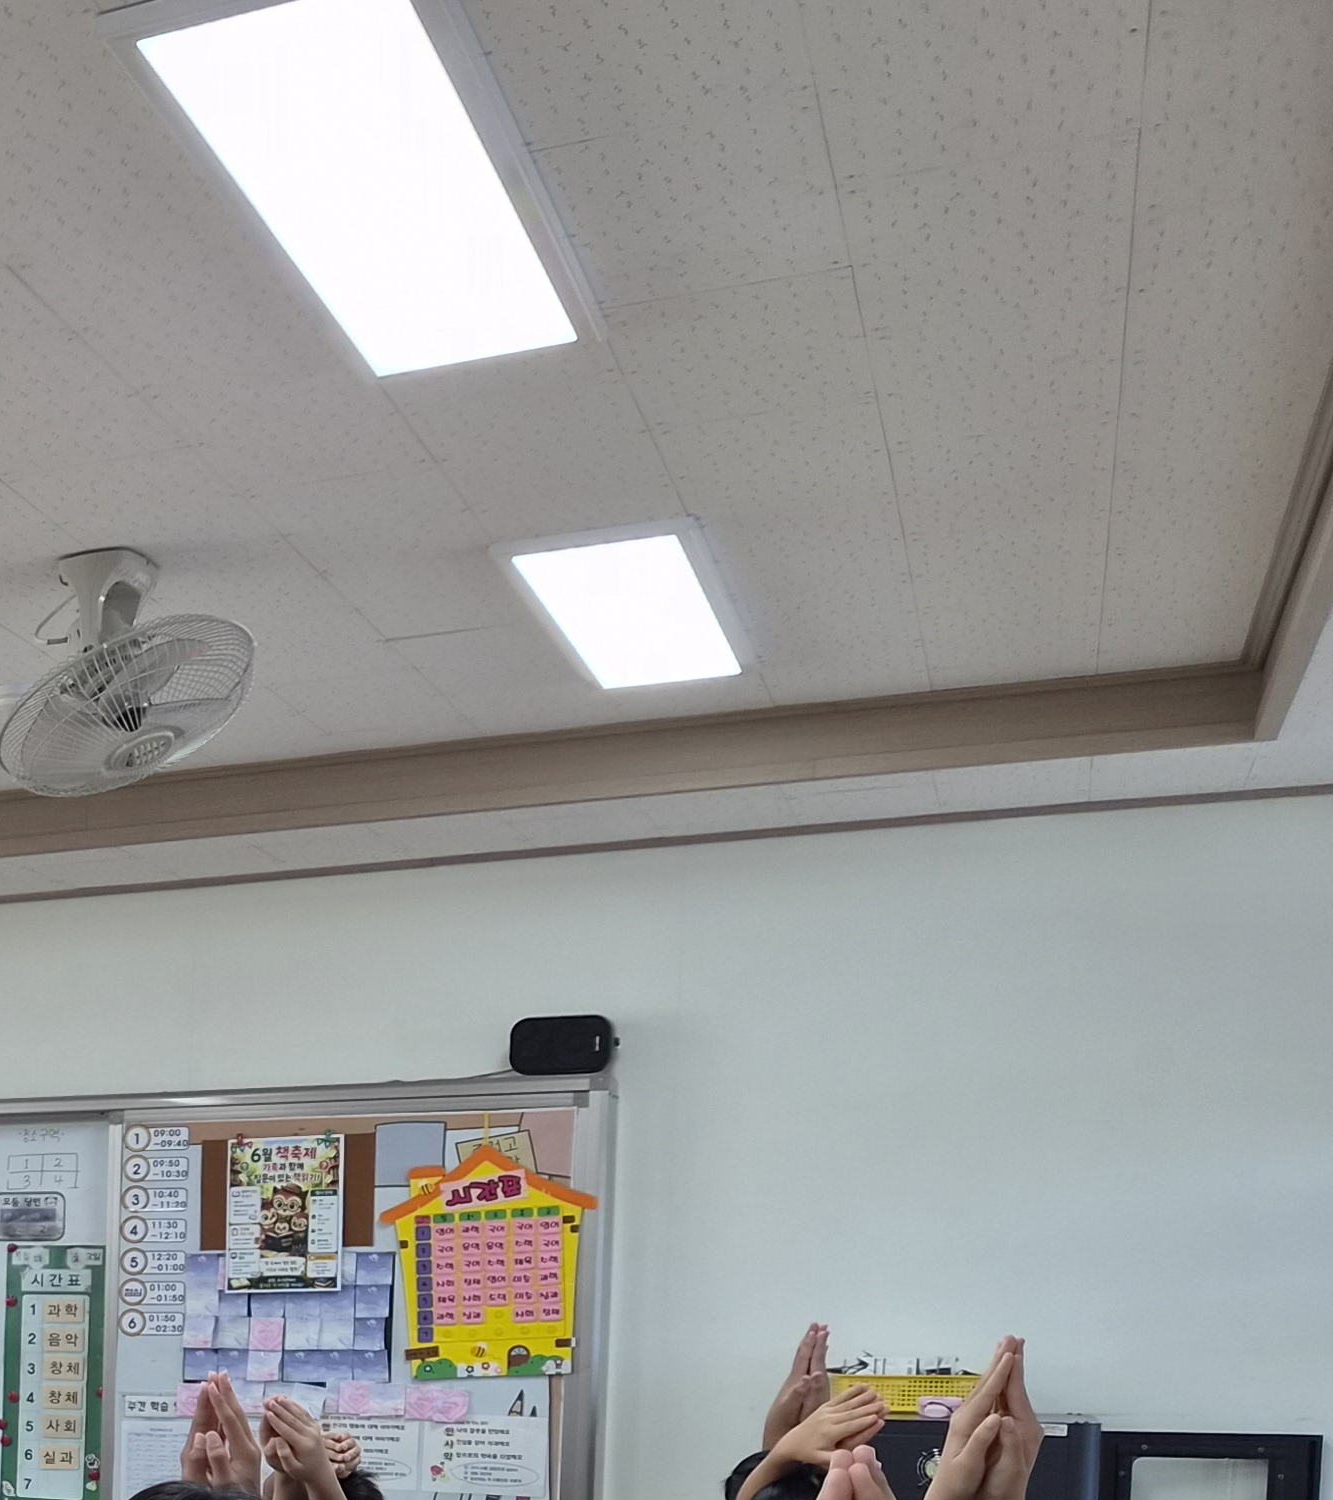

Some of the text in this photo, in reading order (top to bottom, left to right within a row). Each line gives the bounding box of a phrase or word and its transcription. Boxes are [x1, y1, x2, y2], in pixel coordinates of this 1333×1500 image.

[134, 1133, 139, 1145] 1
[154, 1129, 181, 1137] 09:00
[251, 1145, 317, 1162] 6월 책축제
[133, 1164, 141, 1175] 2
[289, 1163, 304, 1171] 함께
[445, 1174, 522, 1207] 시간표
[132, 1194, 140, 1206] 3
[130, 1225, 138, 1236] 4
[152, 1221, 178, 1229] 11:30
[130, 1257, 138, 1268] 5
[152, 1253, 178, 1261] 12:20
[31, 1273, 81, 1288] 시간표
[30, 1304, 79, 1318] 1 과학
[128, 1318, 137, 1329] 6
[28, 1333, 79, 1347] 2 음악
[27, 1361, 80, 1376] 3 창체
[26, 1390, 78, 1405] 4 창체
[128, 1401, 169, 1412] 주간 학습
[25, 1419, 77, 1434] 5 사회
[24, 1449, 73, 1465] 6 실과
[24, 1479, 32, 1489] 7
